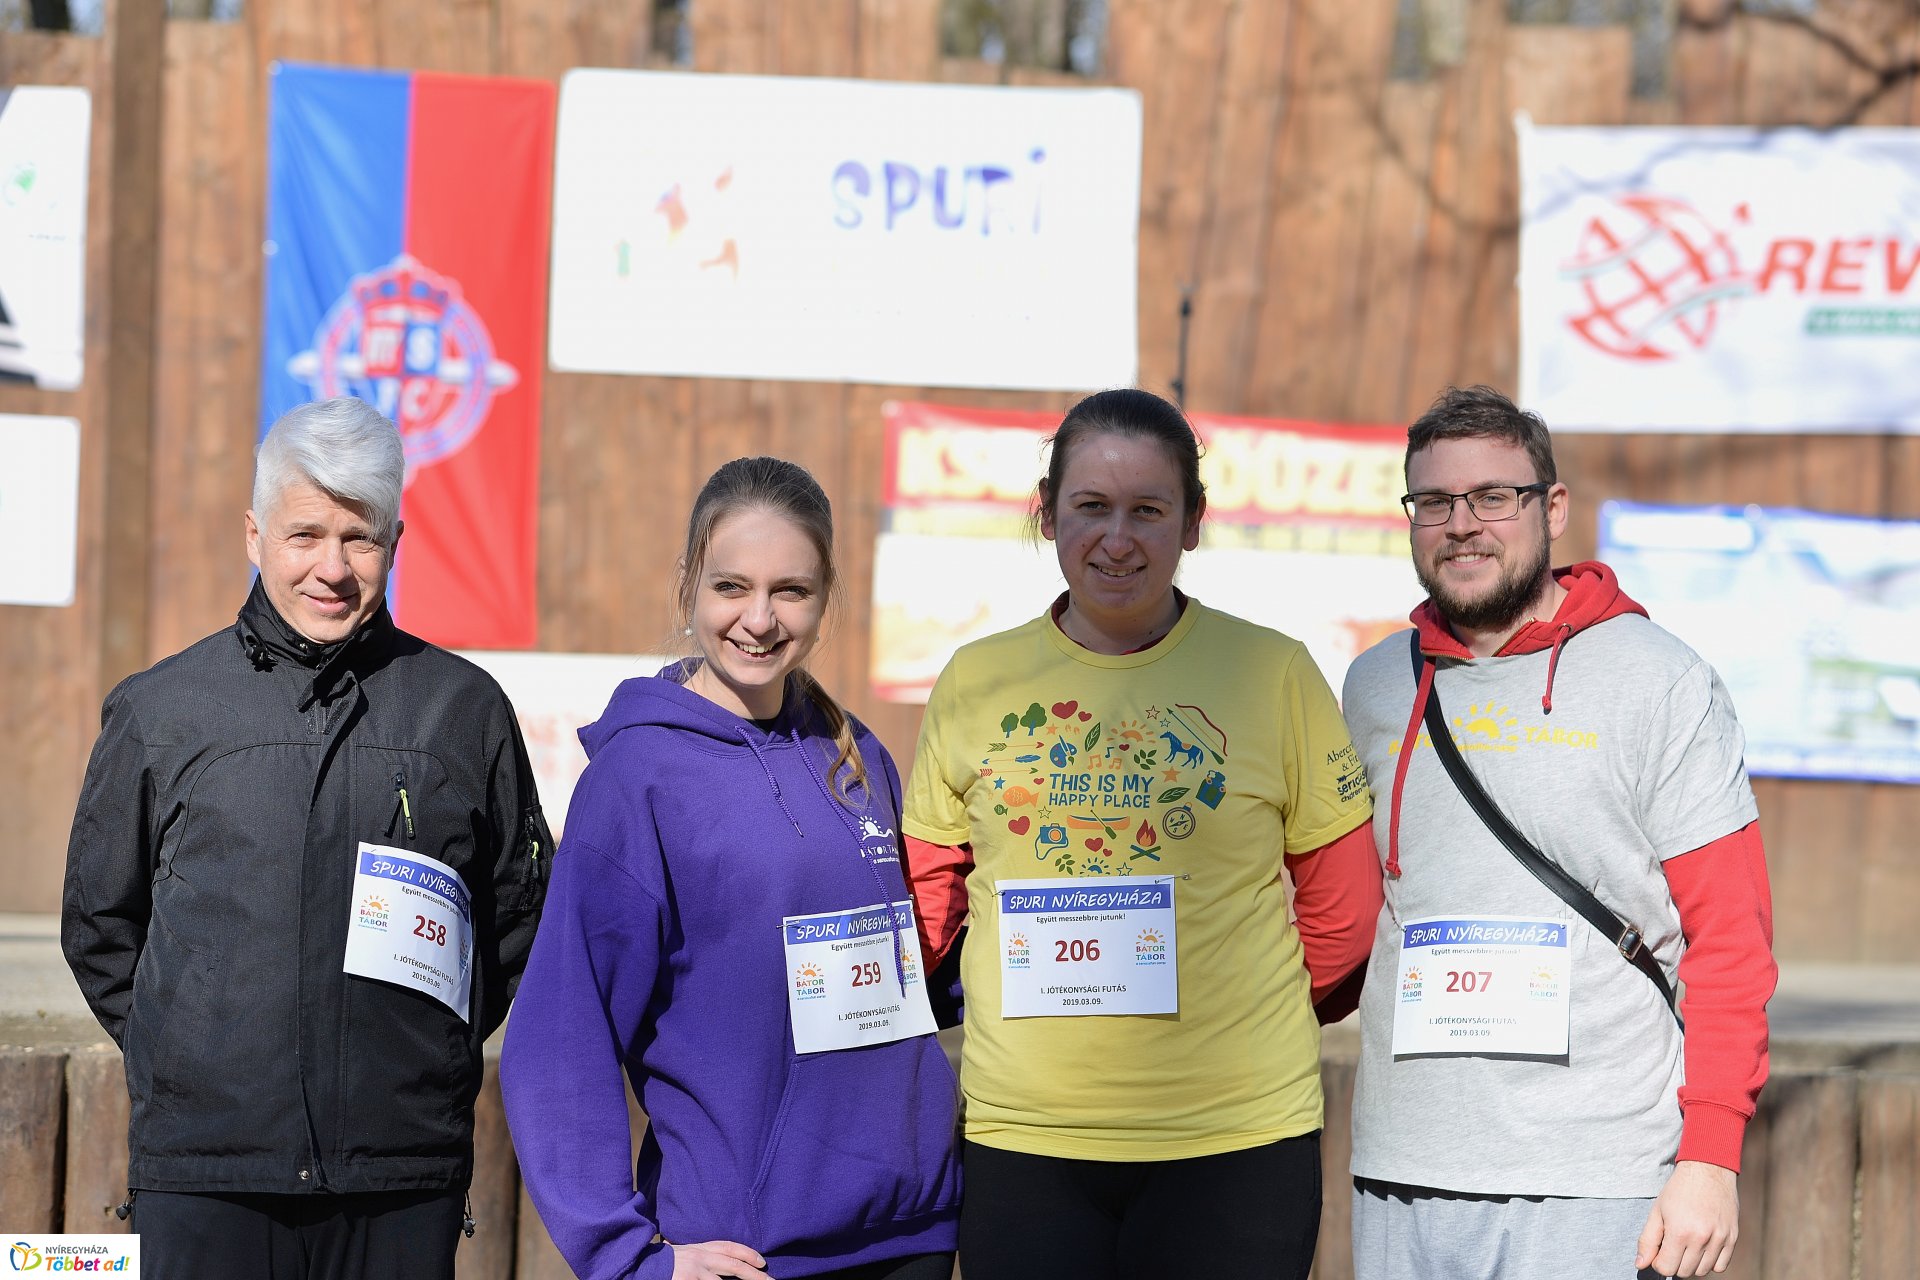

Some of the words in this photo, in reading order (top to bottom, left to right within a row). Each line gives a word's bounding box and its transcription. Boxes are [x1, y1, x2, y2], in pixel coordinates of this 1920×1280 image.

[1049, 773, 1092, 792] THIS
[1098, 773, 1116, 793] IS
[1122, 775, 1155, 793] MY
[1048, 792, 1099, 807] HAPPY
[1103, 794, 1151, 809] PLACE
[370, 860, 415, 880] SPURI
[1010, 895, 1046, 910] SPURI
[1051, 889, 1163, 910] NYÍREGYHÁZA
[359, 908, 390, 920] BÁTOR
[1036, 916, 1058, 925] Együtt
[1059, 914, 1099, 923] messzebbre
[1100, 913, 1127, 923] jutunk!
[359, 916, 388, 928] TÁBOR
[413, 915, 447, 947] 258
[796, 922, 841, 940] SPURI
[1409, 927, 1442, 945] SPURI
[1446, 924, 1560, 944] NYÍREGYHÁZA
[830, 943, 853, 952] Együtt
[1008, 948, 1030, 957] BÁTOR
[1055, 939, 1101, 963] 206
[1135, 944, 1166, 953] BÁTOR
[1431, 948, 1451, 956] Együtt
[1008, 956, 1030, 965] TÁBOR
[1135, 952, 1166, 961] TÁBOR
[851, 961, 883, 988] 259
[796, 978, 825, 988] BÁTOR
[1446, 970, 1494, 993] 207
[796, 986, 826, 996] TÁBOR
[1046, 984, 1101, 995] JÓTÉKONYSÁGI
[1102, 983, 1127, 993] FUTÁS
[1062, 997, 1104, 1006] 2019.03.09.
[844, 1006, 887, 1021] JÓTÉKONYSÁGI
[1435, 1015, 1491, 1025] JÓTÉKONYSÁGI
